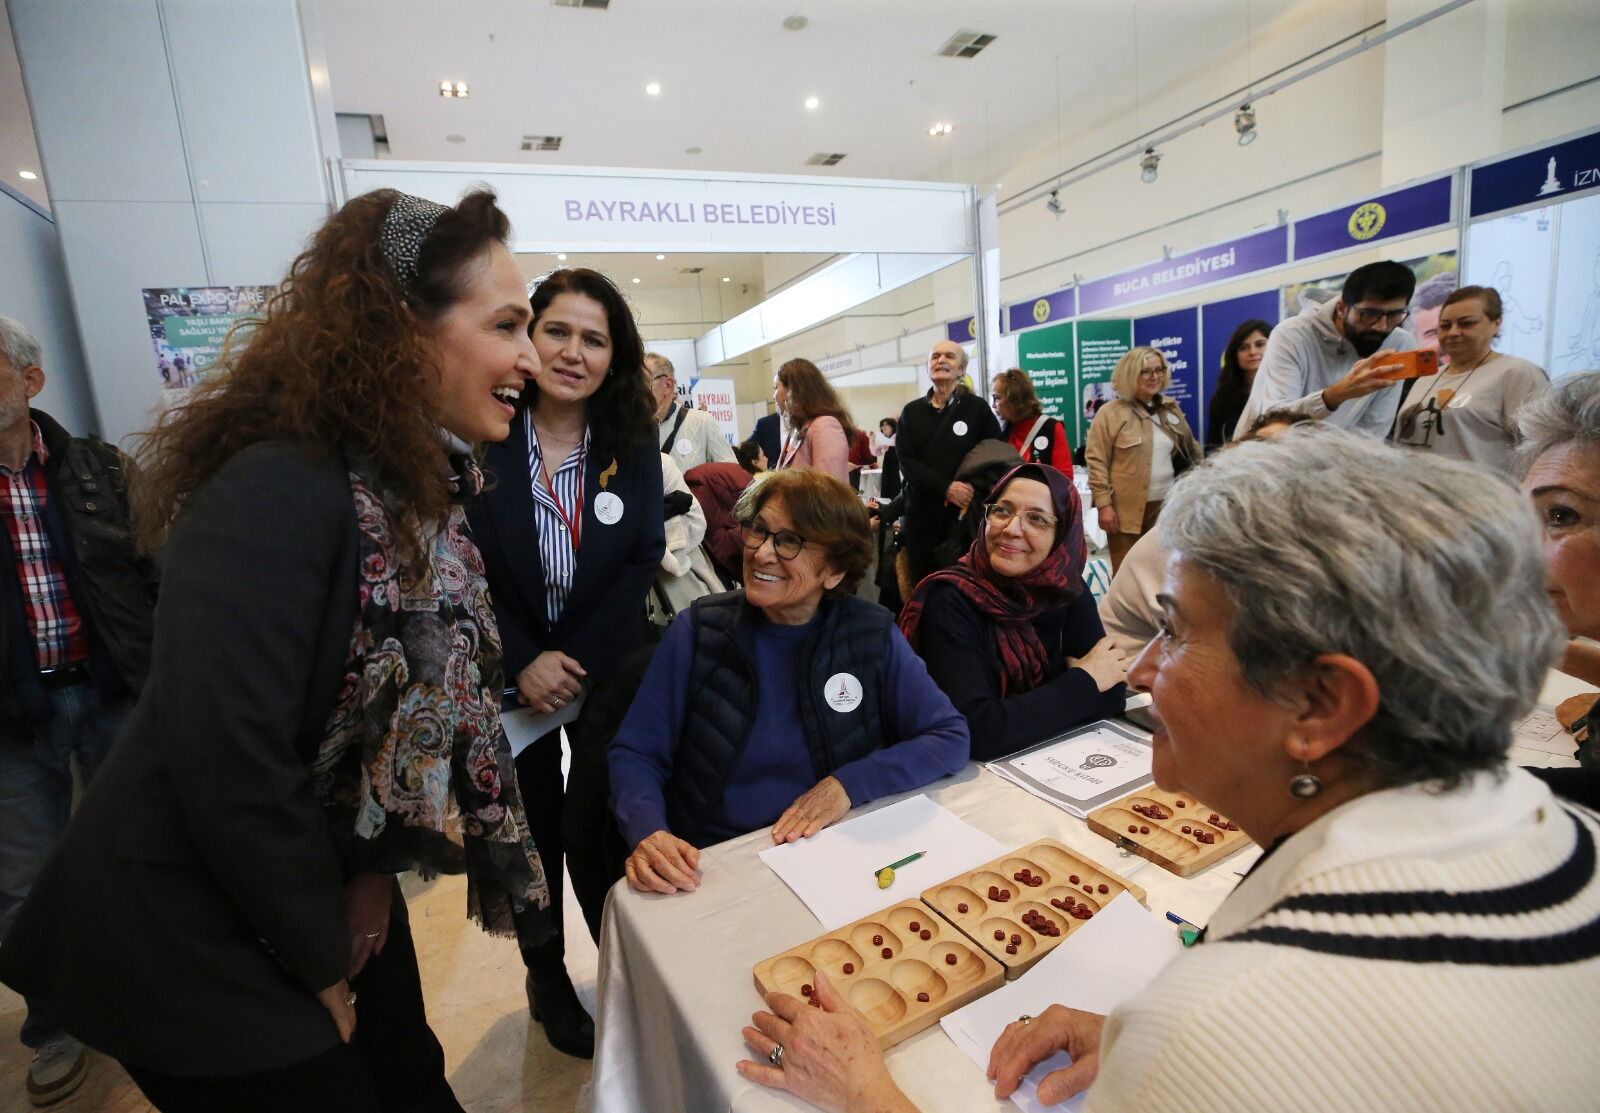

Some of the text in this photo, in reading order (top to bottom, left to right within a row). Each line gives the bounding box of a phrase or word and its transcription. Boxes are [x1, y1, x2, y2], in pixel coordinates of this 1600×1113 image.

[564, 200, 837, 226] BAYRAKLI BELEDİYESİ
[1113, 247, 1236, 296] BUCA BELEDİYESİ
[160, 291, 264, 306] PAL EXPOCARE
[1150, 336, 1183, 348] Birlikte
[698, 393, 731, 405] BAYRAKLI
